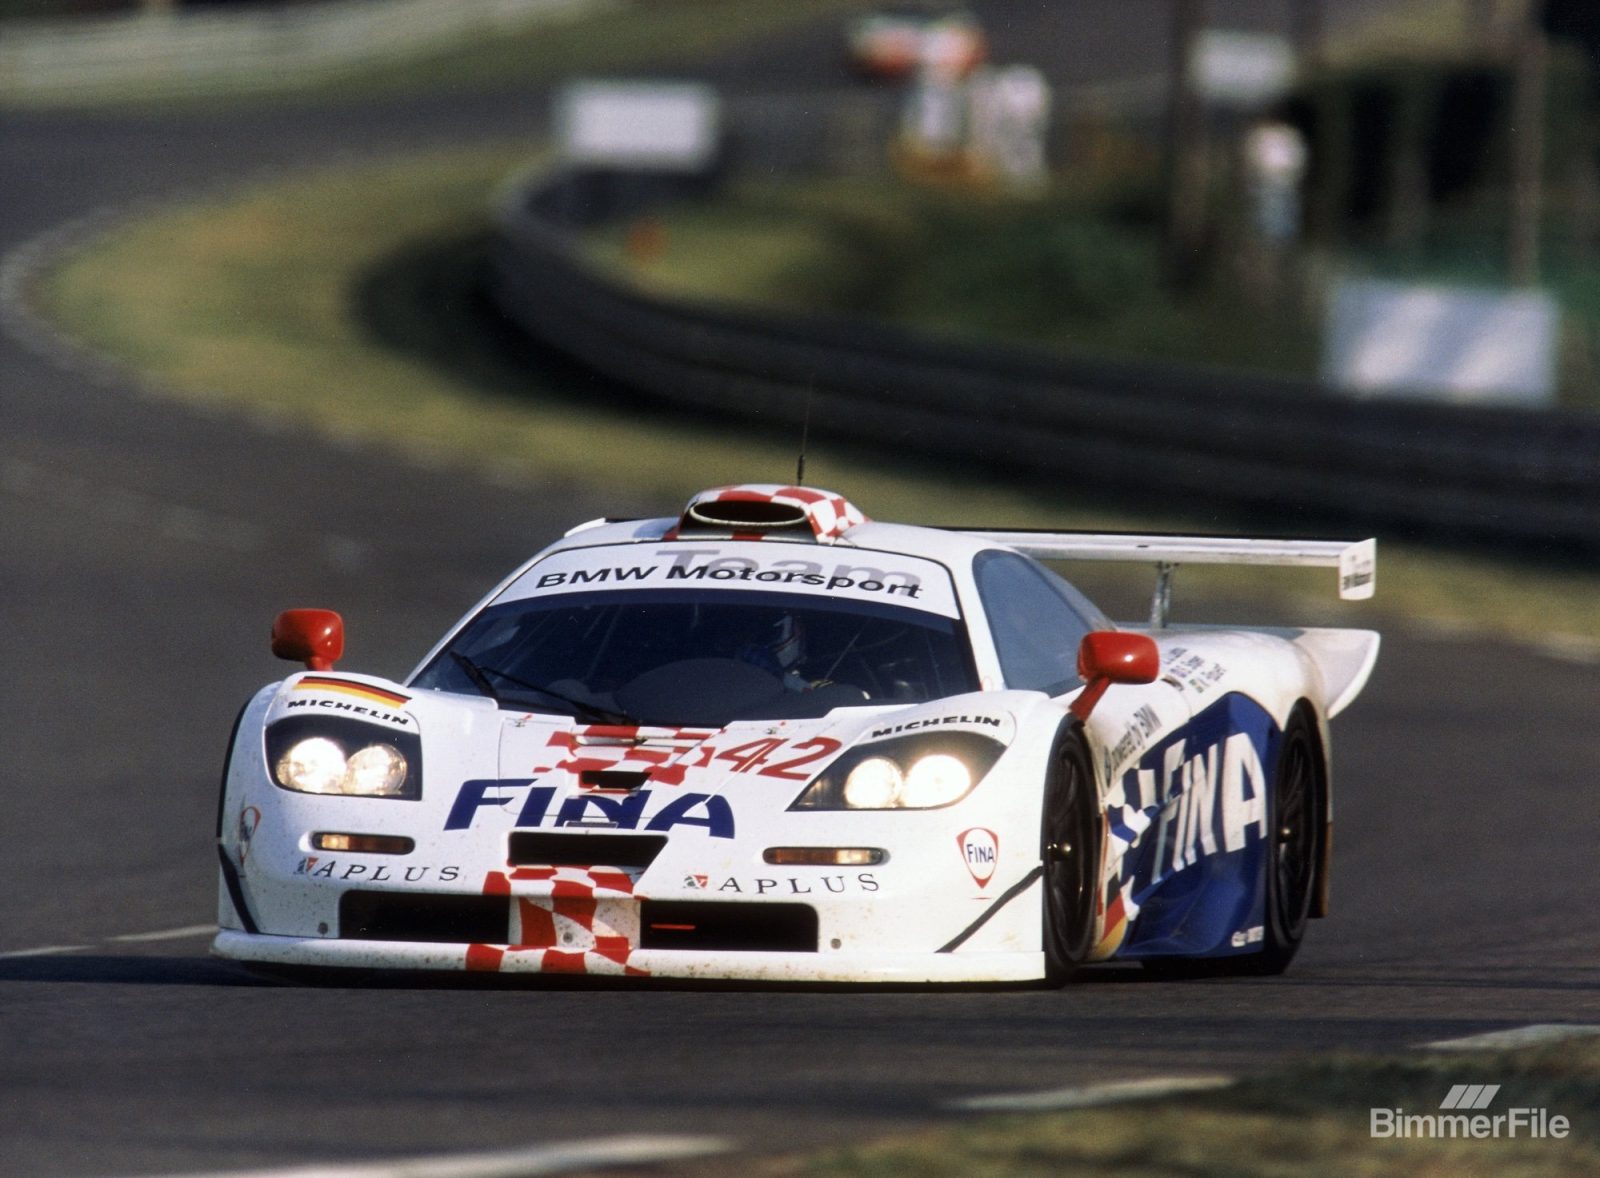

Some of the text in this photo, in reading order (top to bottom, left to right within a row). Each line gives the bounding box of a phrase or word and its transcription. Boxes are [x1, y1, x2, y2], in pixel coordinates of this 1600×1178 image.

[535, 565, 923, 600] BMW Motorsport
[655, 549, 922, 597] Team
[287, 700, 409, 725] MICHELIN
[872, 715, 1000, 738] MICHELIN
[715, 736, 842, 780] 42
[443, 778, 735, 840] FINA
[1152, 732, 1268, 884] FINA
[965, 843, 995, 863] FINA
[313, 861, 460, 881] APLUS
[719, 873, 880, 894] APLUS
